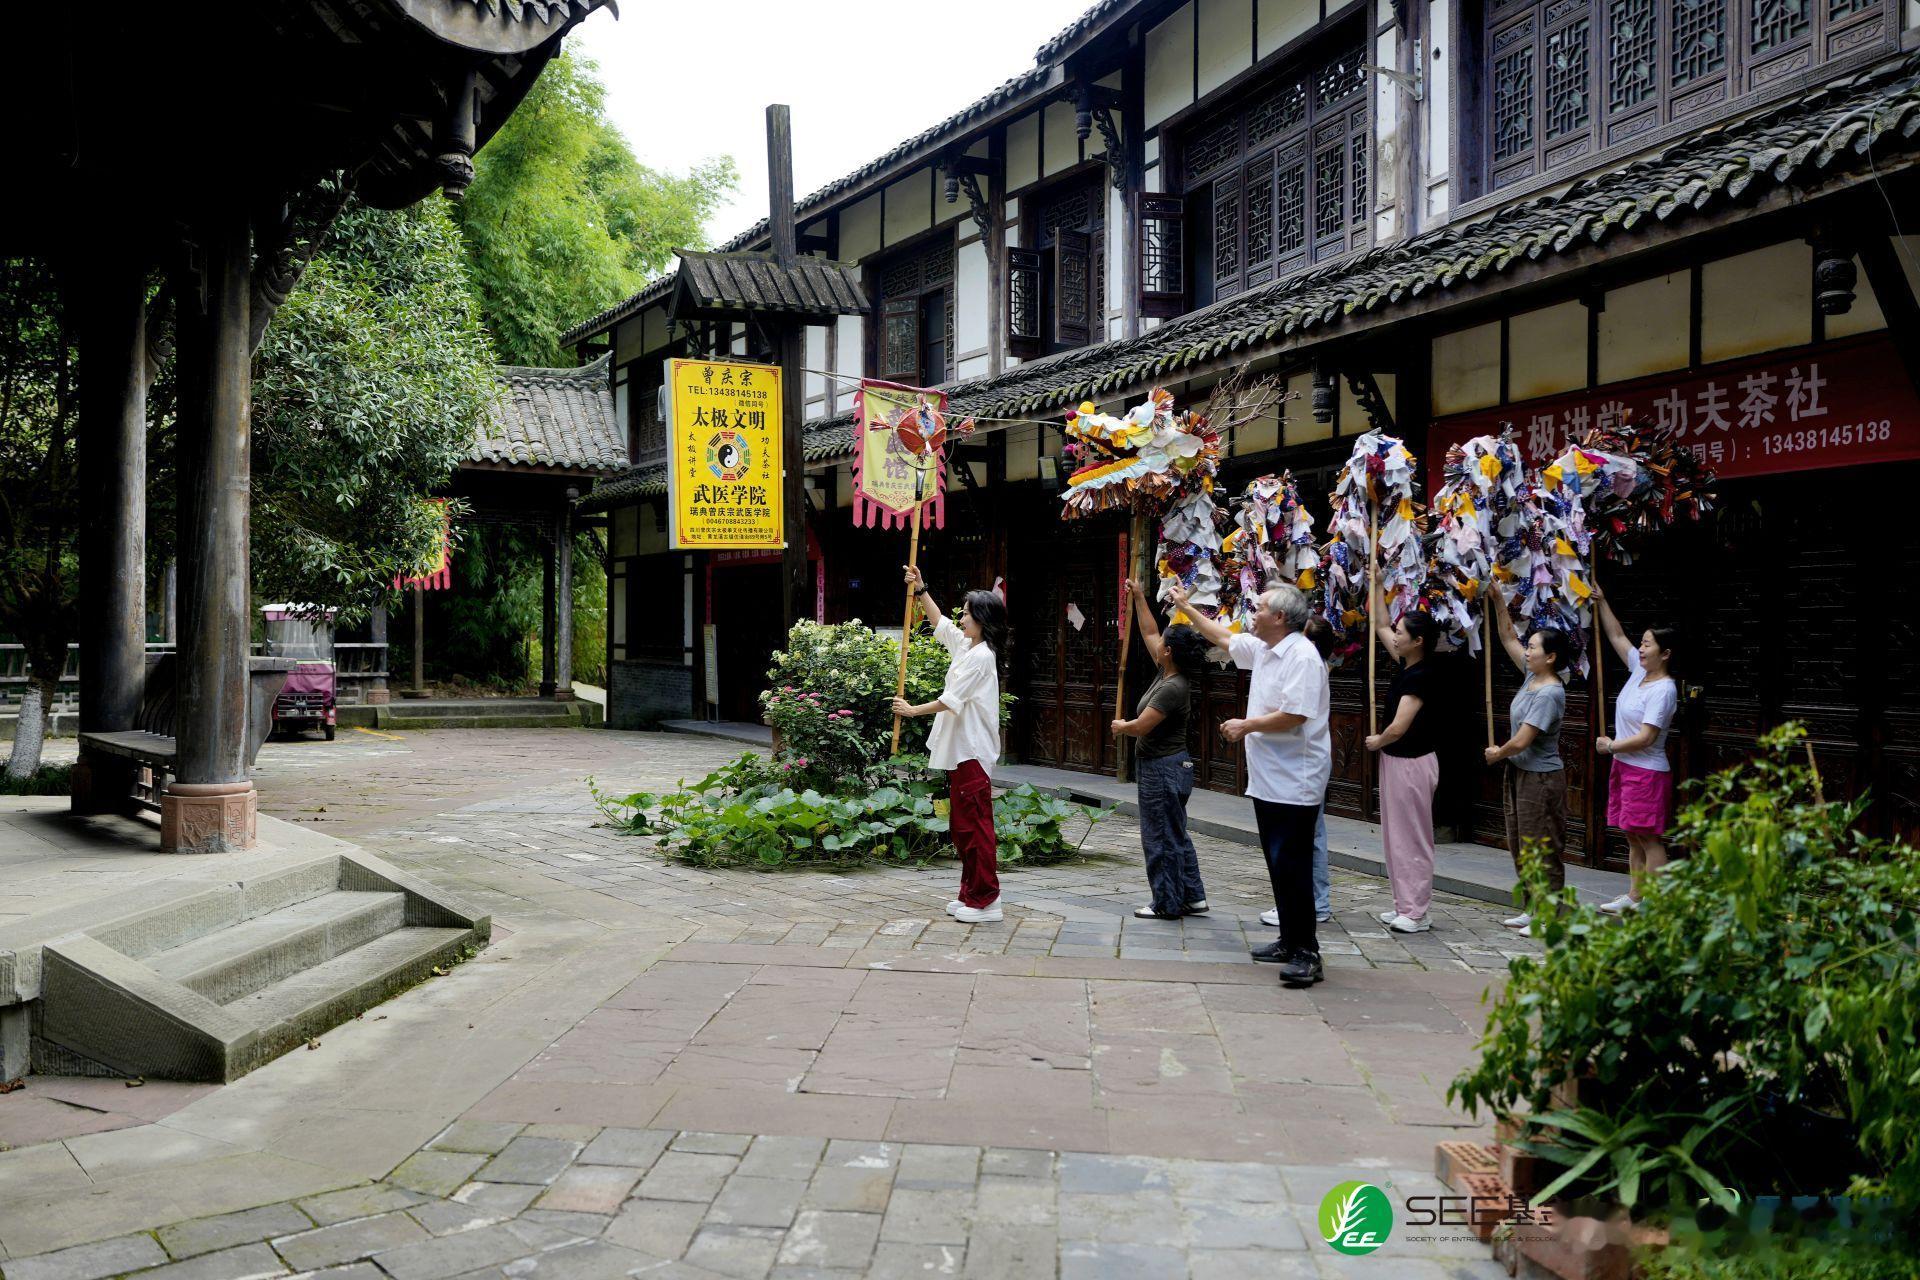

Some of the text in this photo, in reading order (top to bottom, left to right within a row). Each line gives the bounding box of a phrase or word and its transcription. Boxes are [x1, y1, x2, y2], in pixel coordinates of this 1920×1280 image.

[702, 366, 753, 386] 曾庆宗
[688, 386, 768, 399] TEL:13438145138
[691, 406, 766, 430] 太极文明
[1507, 363, 1829, 460] 极讲堂 功夫茶社
[1762, 419, 1892, 455] 13438145138
[687, 432, 697, 478] 太极讲堂
[693, 484, 767, 506] 武医学院
[689, 506, 771, 518] 瑞典曾庆宗武医学院
